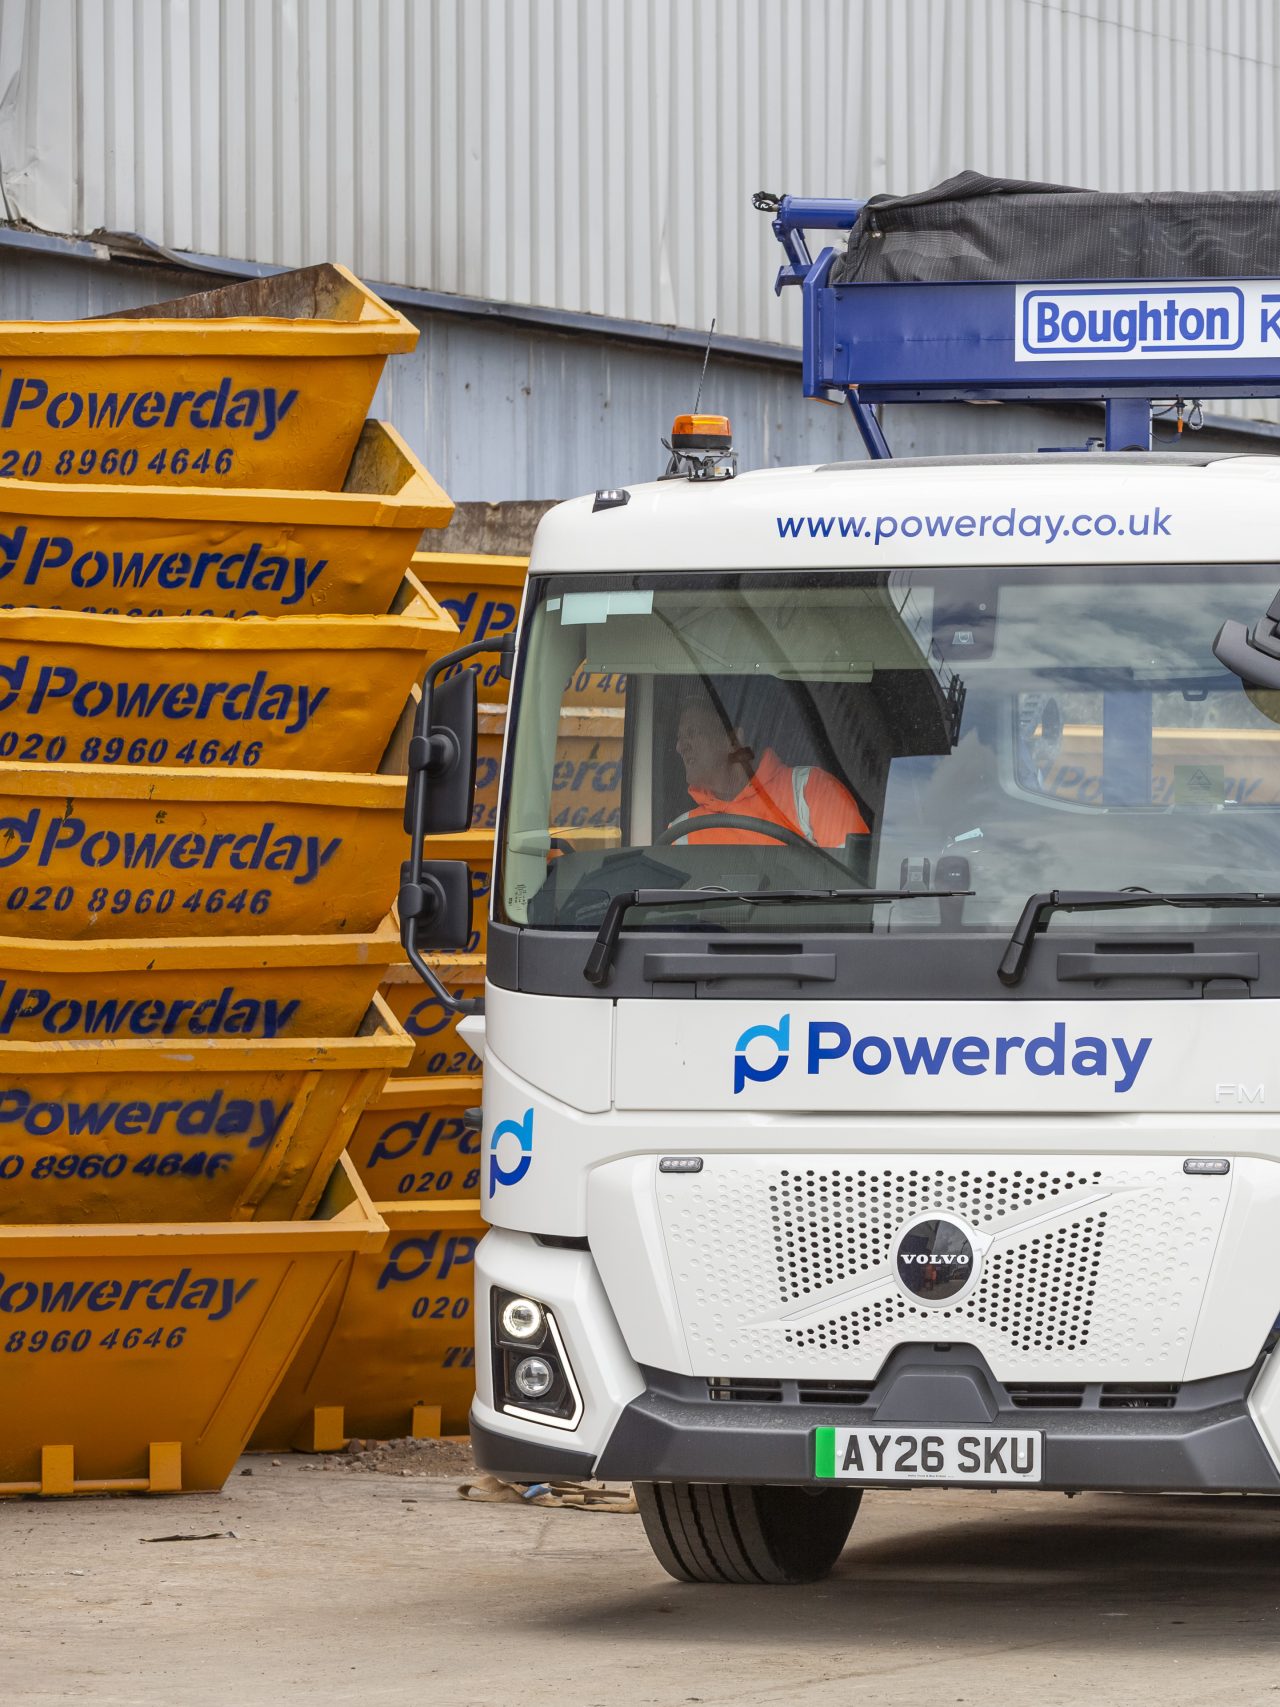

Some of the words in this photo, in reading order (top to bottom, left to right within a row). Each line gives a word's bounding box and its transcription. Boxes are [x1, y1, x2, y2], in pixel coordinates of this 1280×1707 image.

[1037, 299, 1230, 350] Boughton
[1, 377, 299, 441] Powerday
[0, 450, 42, 477] 20
[55, 449, 138, 476] 8960
[147, 448, 234, 475] 4646
[776, 507, 1173, 545] www.powerday.co.uk
[23, 536, 328, 605] Powerday
[27, 666, 331, 734] Powerday
[0, 731, 67, 762] 020
[80, 737, 168, 764] 8960
[176, 740, 263, 766] 4646
[38, 817, 343, 885] Powerday
[6, 886, 74, 912] 020
[88, 887, 175, 914] 8960
[182, 889, 272, 914] 4646
[1, 987, 302, 1038] Powerday
[807, 1022, 1153, 1093] Powerday
[1214, 1083, 1266, 1105] FM
[0, 1089, 293, 1149] Powerday
[31, 1154, 127, 1180] 8960
[398, 1171, 453, 1194] 020
[900, 1253, 970, 1266] VOLVO
[0, 1268, 259, 1321] owerday
[412, 1296, 469, 1319] 020
[5, 1329, 92, 1353] 8960
[99, 1327, 187, 1350] 4646
[842, 1434, 944, 1473] AY26
[957, 1436, 1034, 1474] SKU
